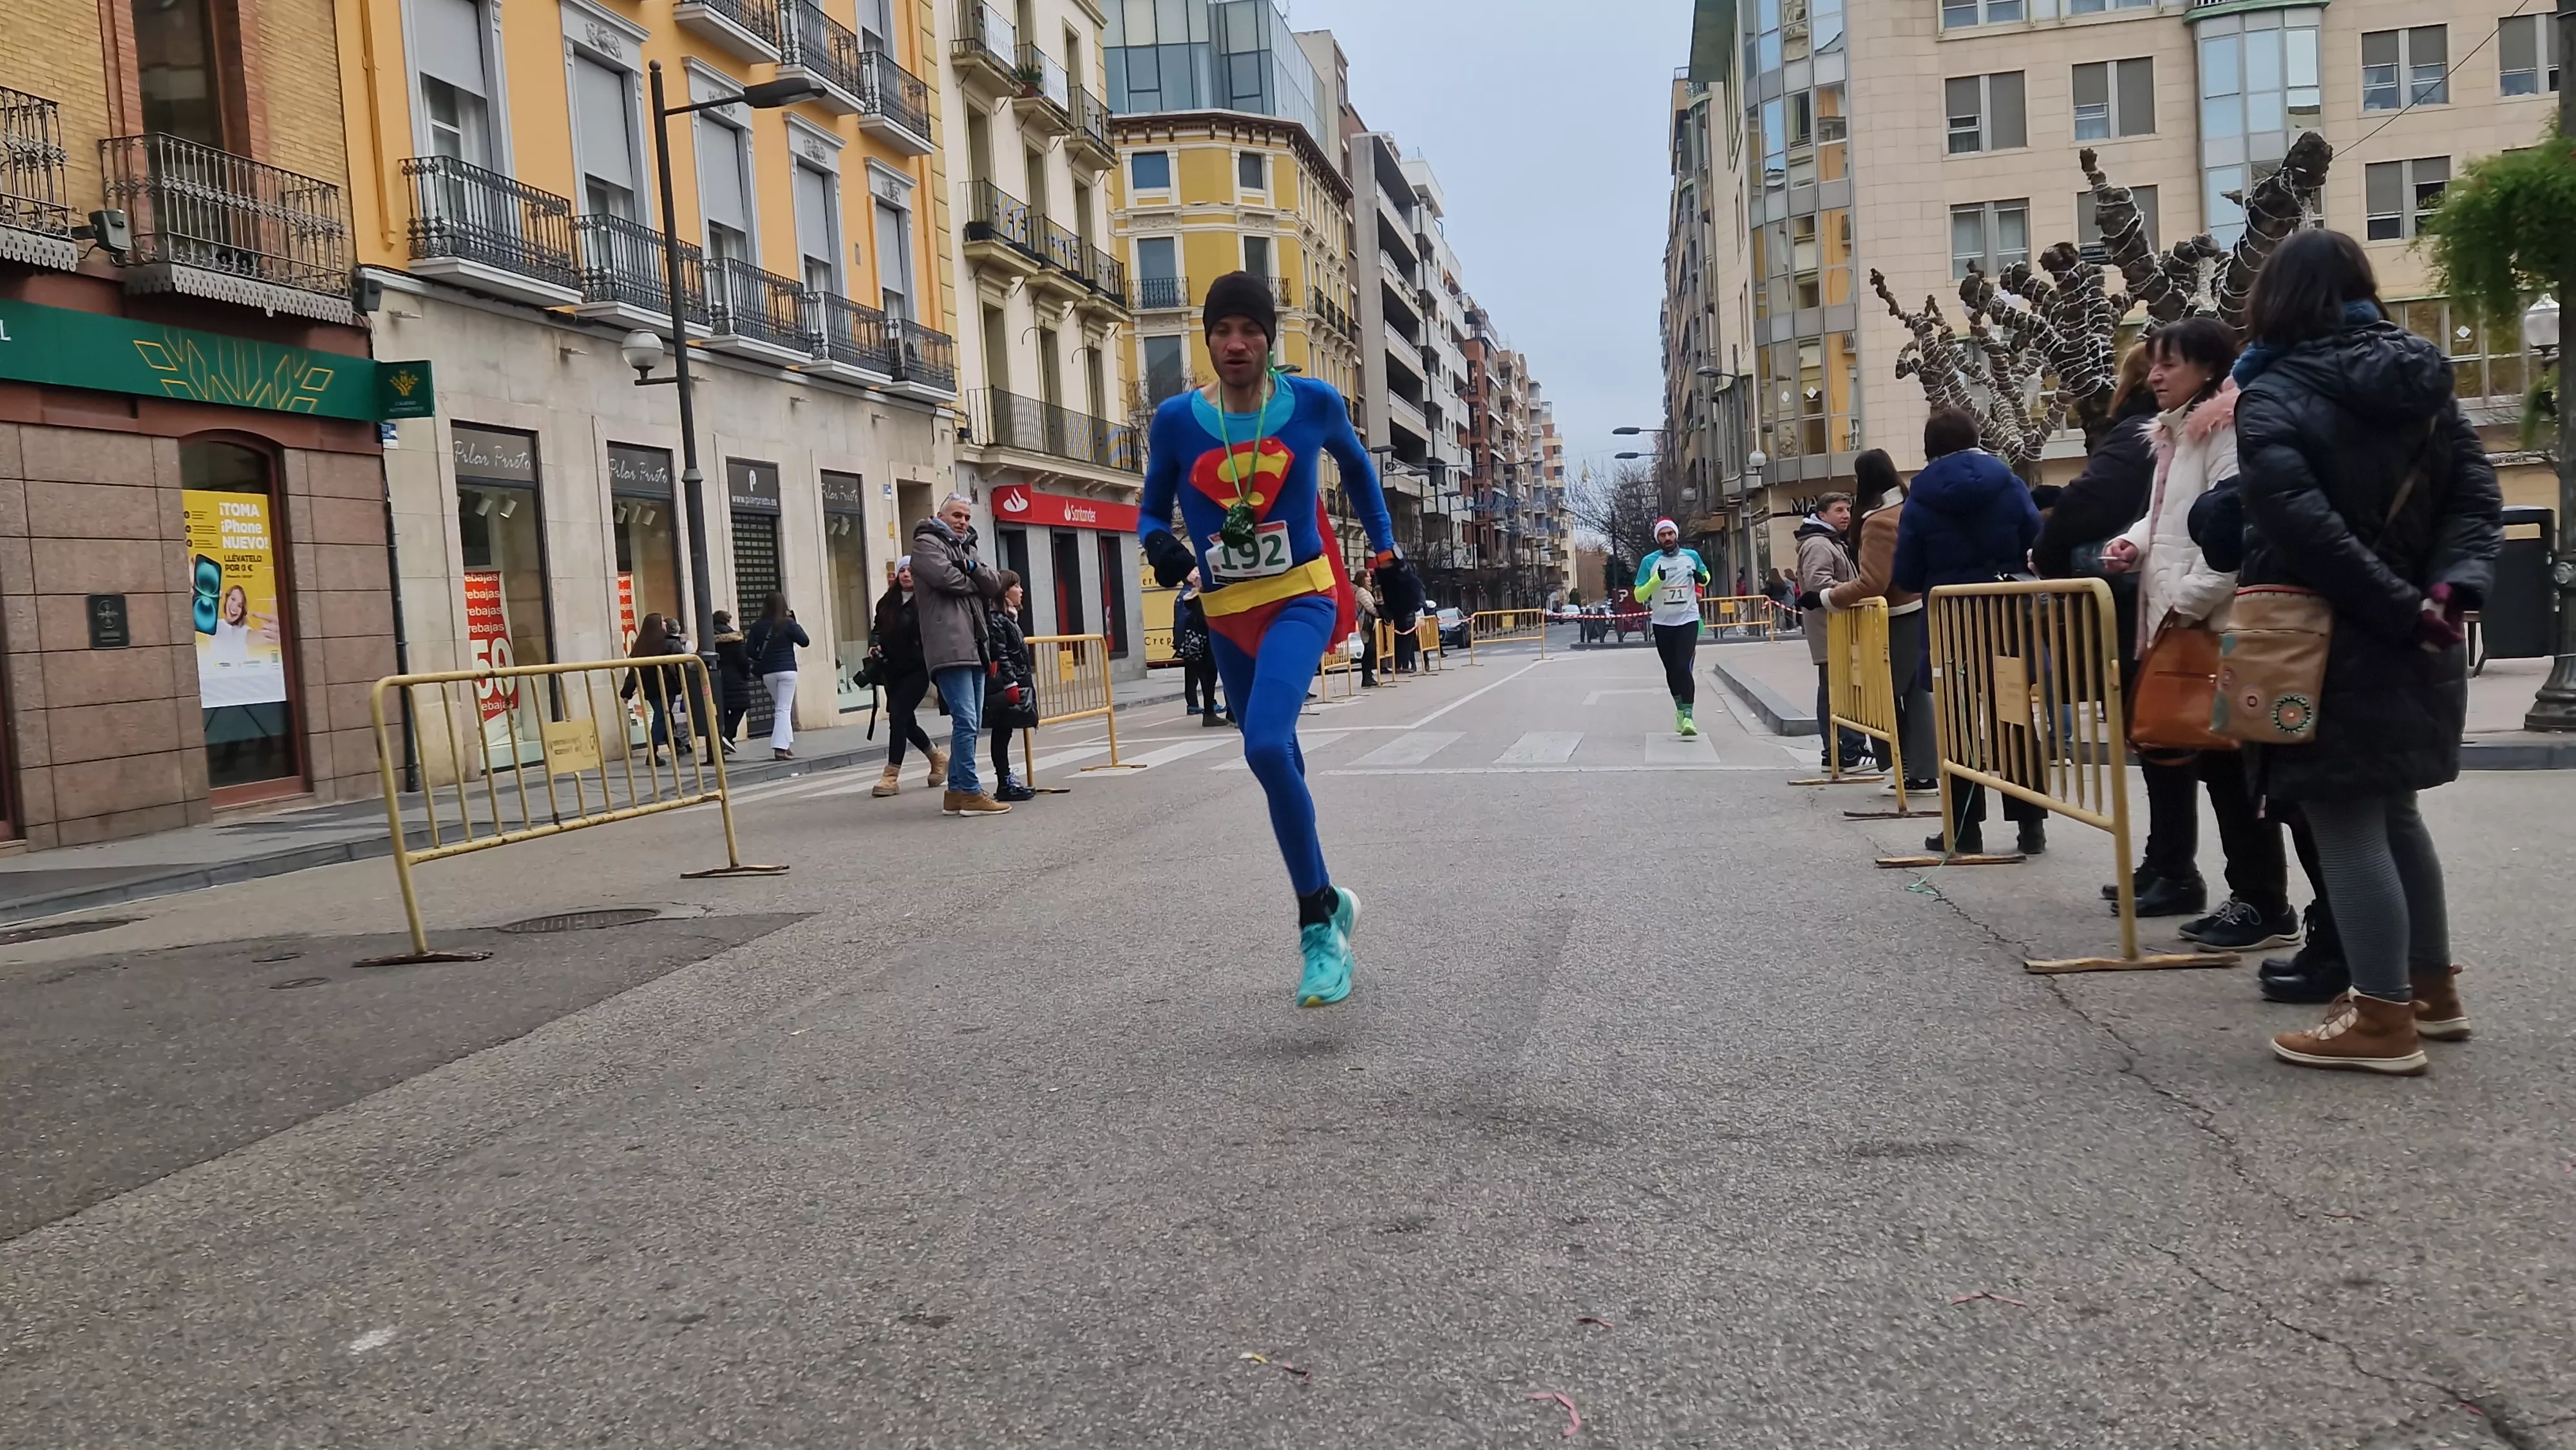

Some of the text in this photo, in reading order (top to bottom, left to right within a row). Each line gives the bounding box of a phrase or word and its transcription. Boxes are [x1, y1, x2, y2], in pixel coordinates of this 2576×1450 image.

[0, 319, 12, 341] L
[453, 440, 531, 470] Pilar Prieto
[609, 458, 668, 484] Pilar Prieto
[219, 502, 260, 517] ¡TOMA
[1070, 504, 1096, 523] Santander
[1790, 495, 1818, 514] MA
[222, 536, 269, 549] NUEVO!
[1218, 534, 1286, 570] 192
[223, 553, 262, 562] LLÉVATELO
[464, 572, 498, 583] ebajas
[1669, 589, 1683, 599] 71
[1144, 636, 1171, 646] Crep
[470, 637, 516, 699] 50
